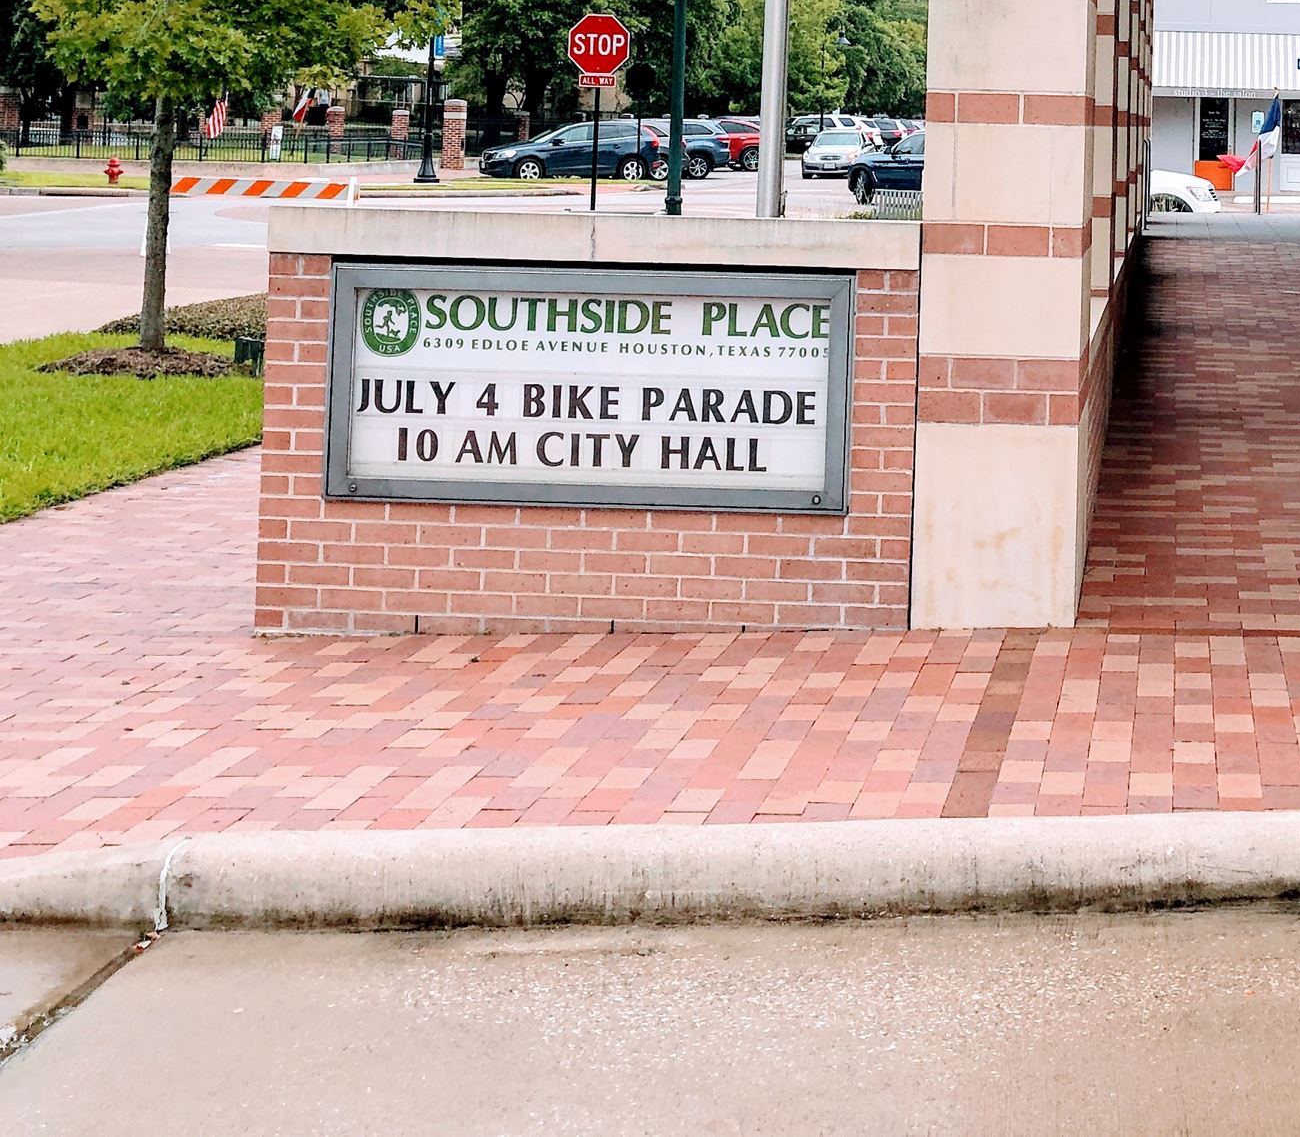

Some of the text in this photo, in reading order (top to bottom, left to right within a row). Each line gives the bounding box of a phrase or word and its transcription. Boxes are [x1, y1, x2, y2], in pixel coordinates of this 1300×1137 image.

[573, 33, 625, 55] STOP
[582, 76, 613, 85] ALL WAY
[1173, 88, 1200, 97] studio
[1203, 88, 1208, 97] 3
[1217, 88, 1231, 98] the
[1233, 89, 1256, 98] salon
[406, 298, 418, 334] PLACE
[425, 294, 829, 340] SOUTHSIDE PLACE
[379, 344, 401, 353] USA
[423, 337, 464, 349] 6309
[471, 338, 529, 352] EDLOE
[535, 340, 608, 353] AVENUE
[356, 378, 816, 425] JULY 4 BIKE PARADE
[398, 427, 767, 472] 10 AM CITY HALL
